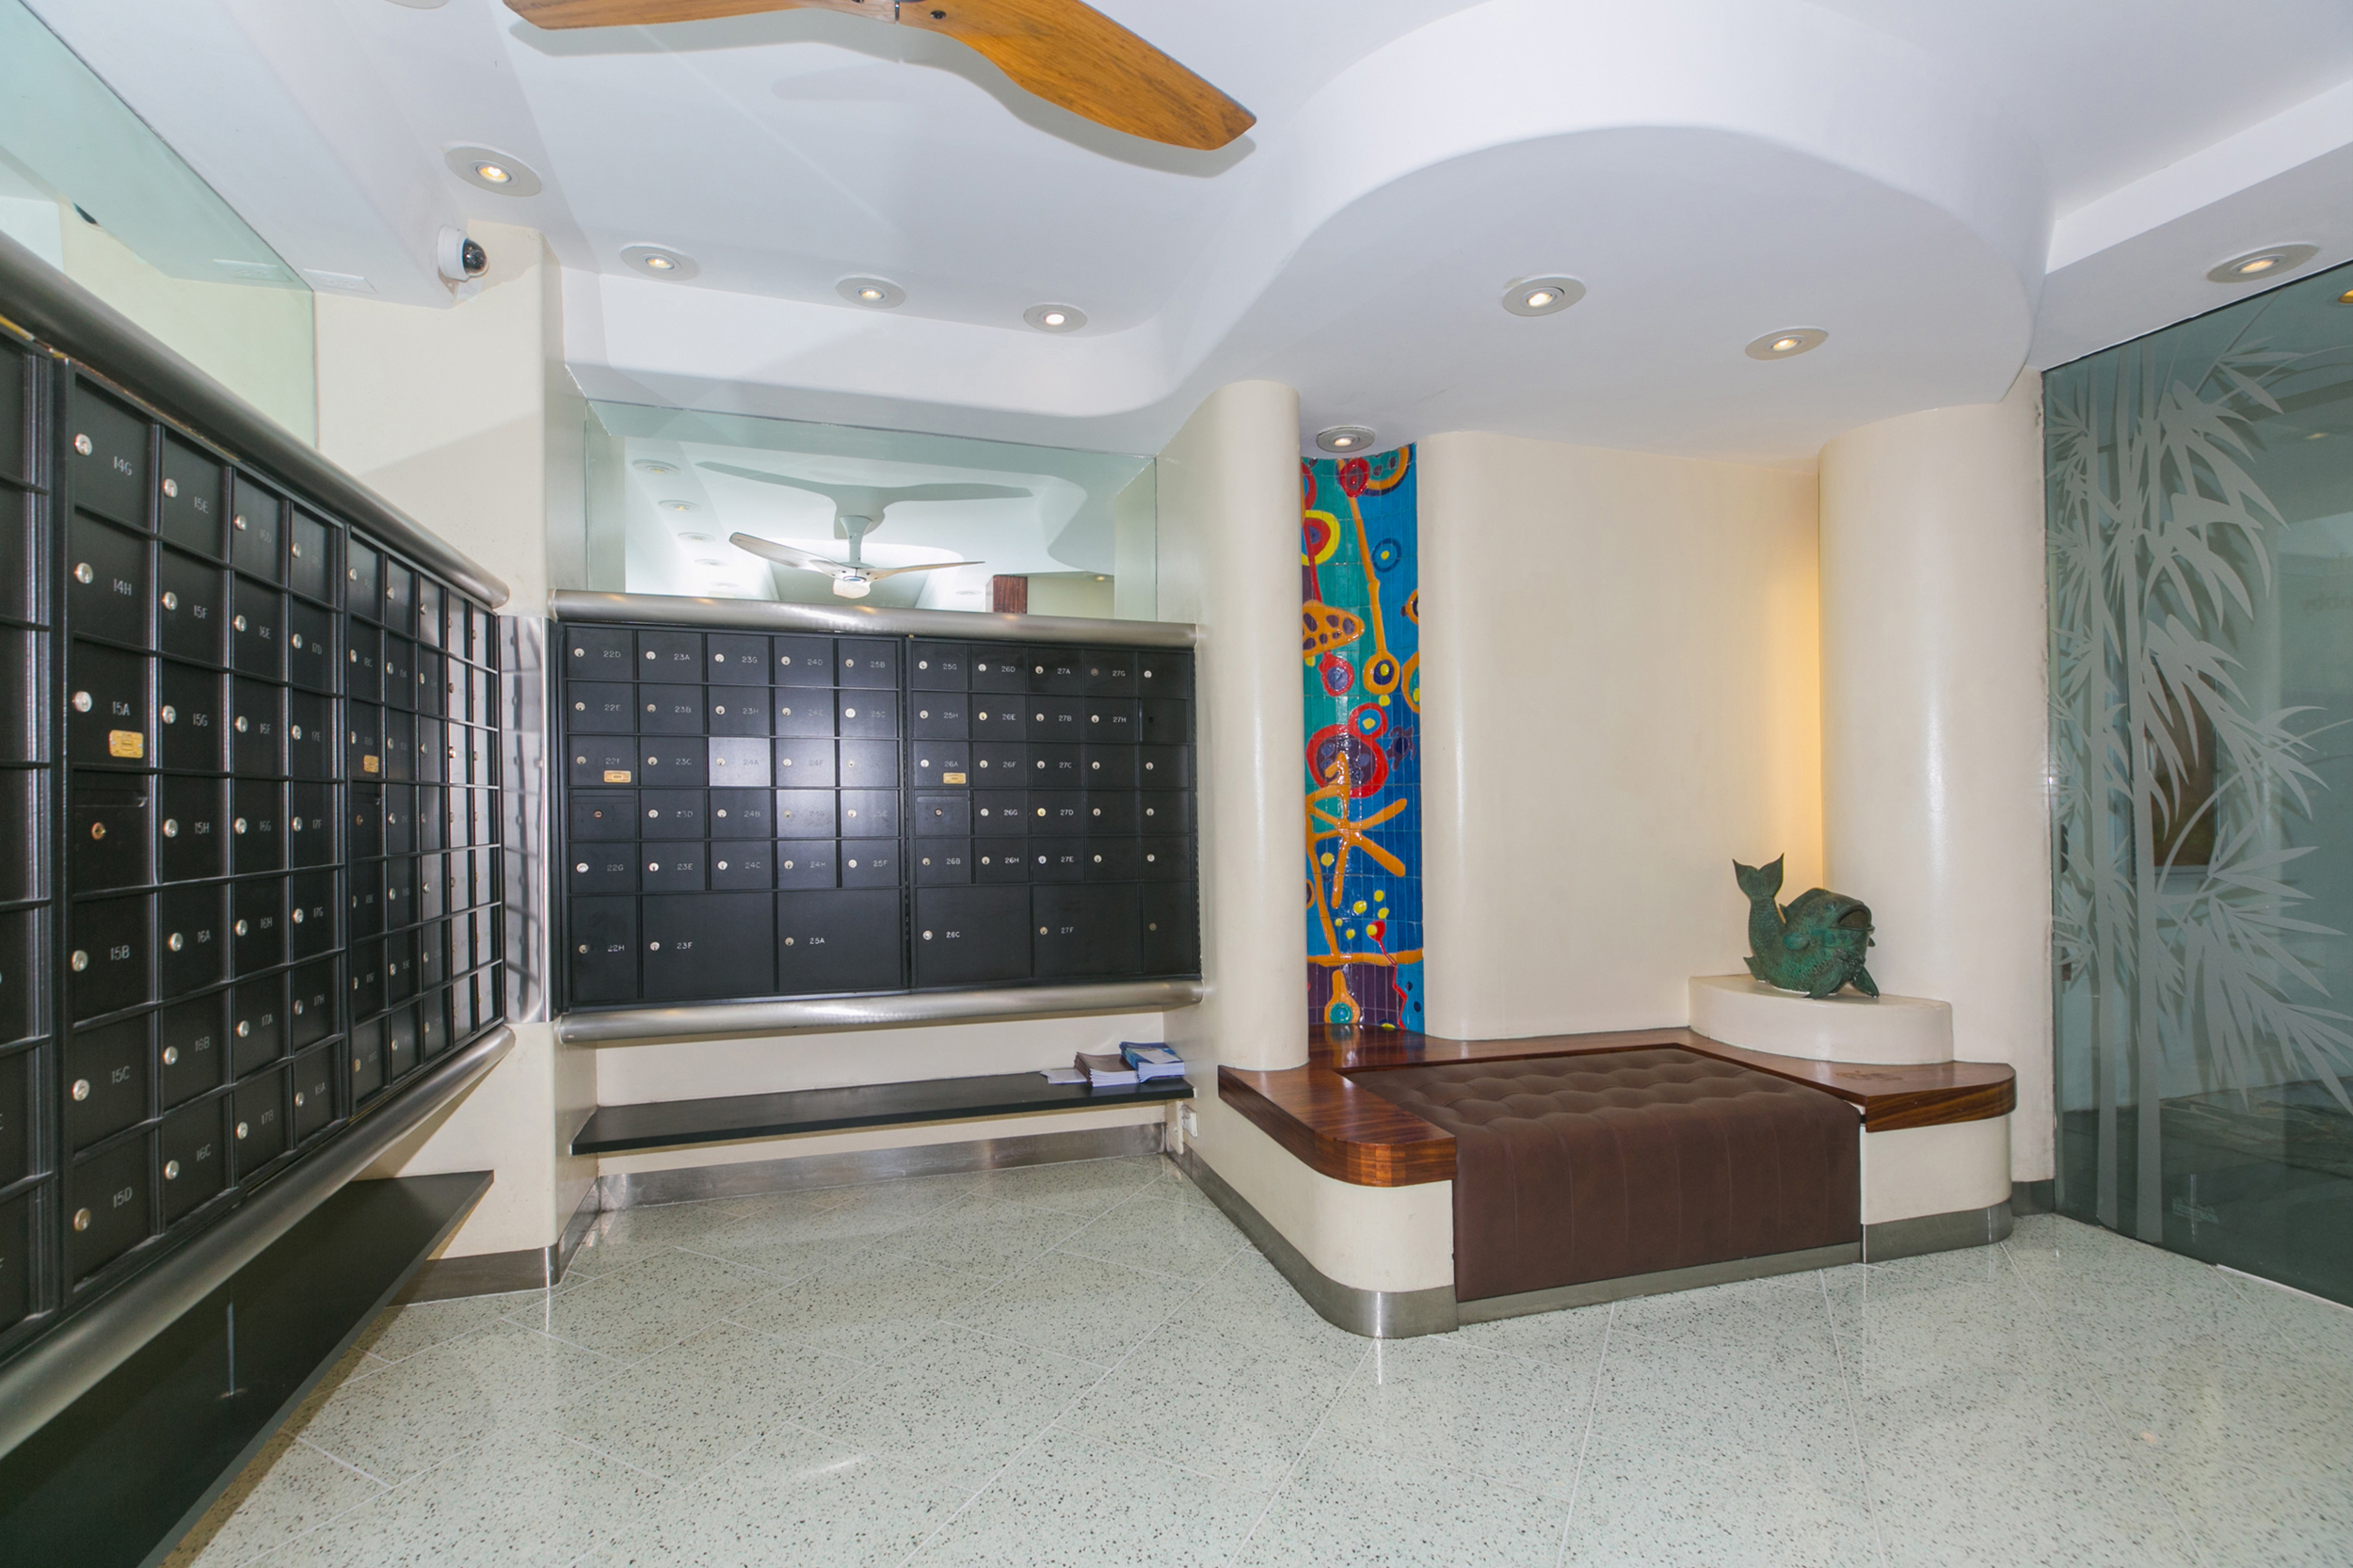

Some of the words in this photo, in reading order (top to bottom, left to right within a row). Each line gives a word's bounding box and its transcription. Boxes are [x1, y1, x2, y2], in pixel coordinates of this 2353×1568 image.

[114, 456, 132, 475] 14G
[194, 497, 208, 513] 15E
[114, 579, 132, 595] 14H
[194, 605, 207, 618] 15F
[260, 626, 270, 639] 16E
[603, 650, 621, 659] 22D
[674, 653, 691, 662] 23A
[742, 655, 758, 664] 23G
[808, 658, 824, 666] 24D
[113, 701, 130, 715] 15A
[675, 705, 692, 713] 23B
[193, 713, 207, 727] 15G
[195, 822, 209, 834] 15H
[260, 821, 271, 831] 16G
[607, 863, 624, 872] 22G
[313, 906, 323, 918] 17G
[261, 917, 272, 929] 16H
[198, 930, 210, 942] 16A
[111, 945, 130, 960] 15B
[262, 1014, 273, 1027] 17A
[195, 1036, 210, 1052] 16B
[112, 1065, 130, 1083] 15C
[262, 1110, 274, 1125] 17B
[197, 1144, 211, 1161] 16C
[113, 1187, 132, 1208] 15D
